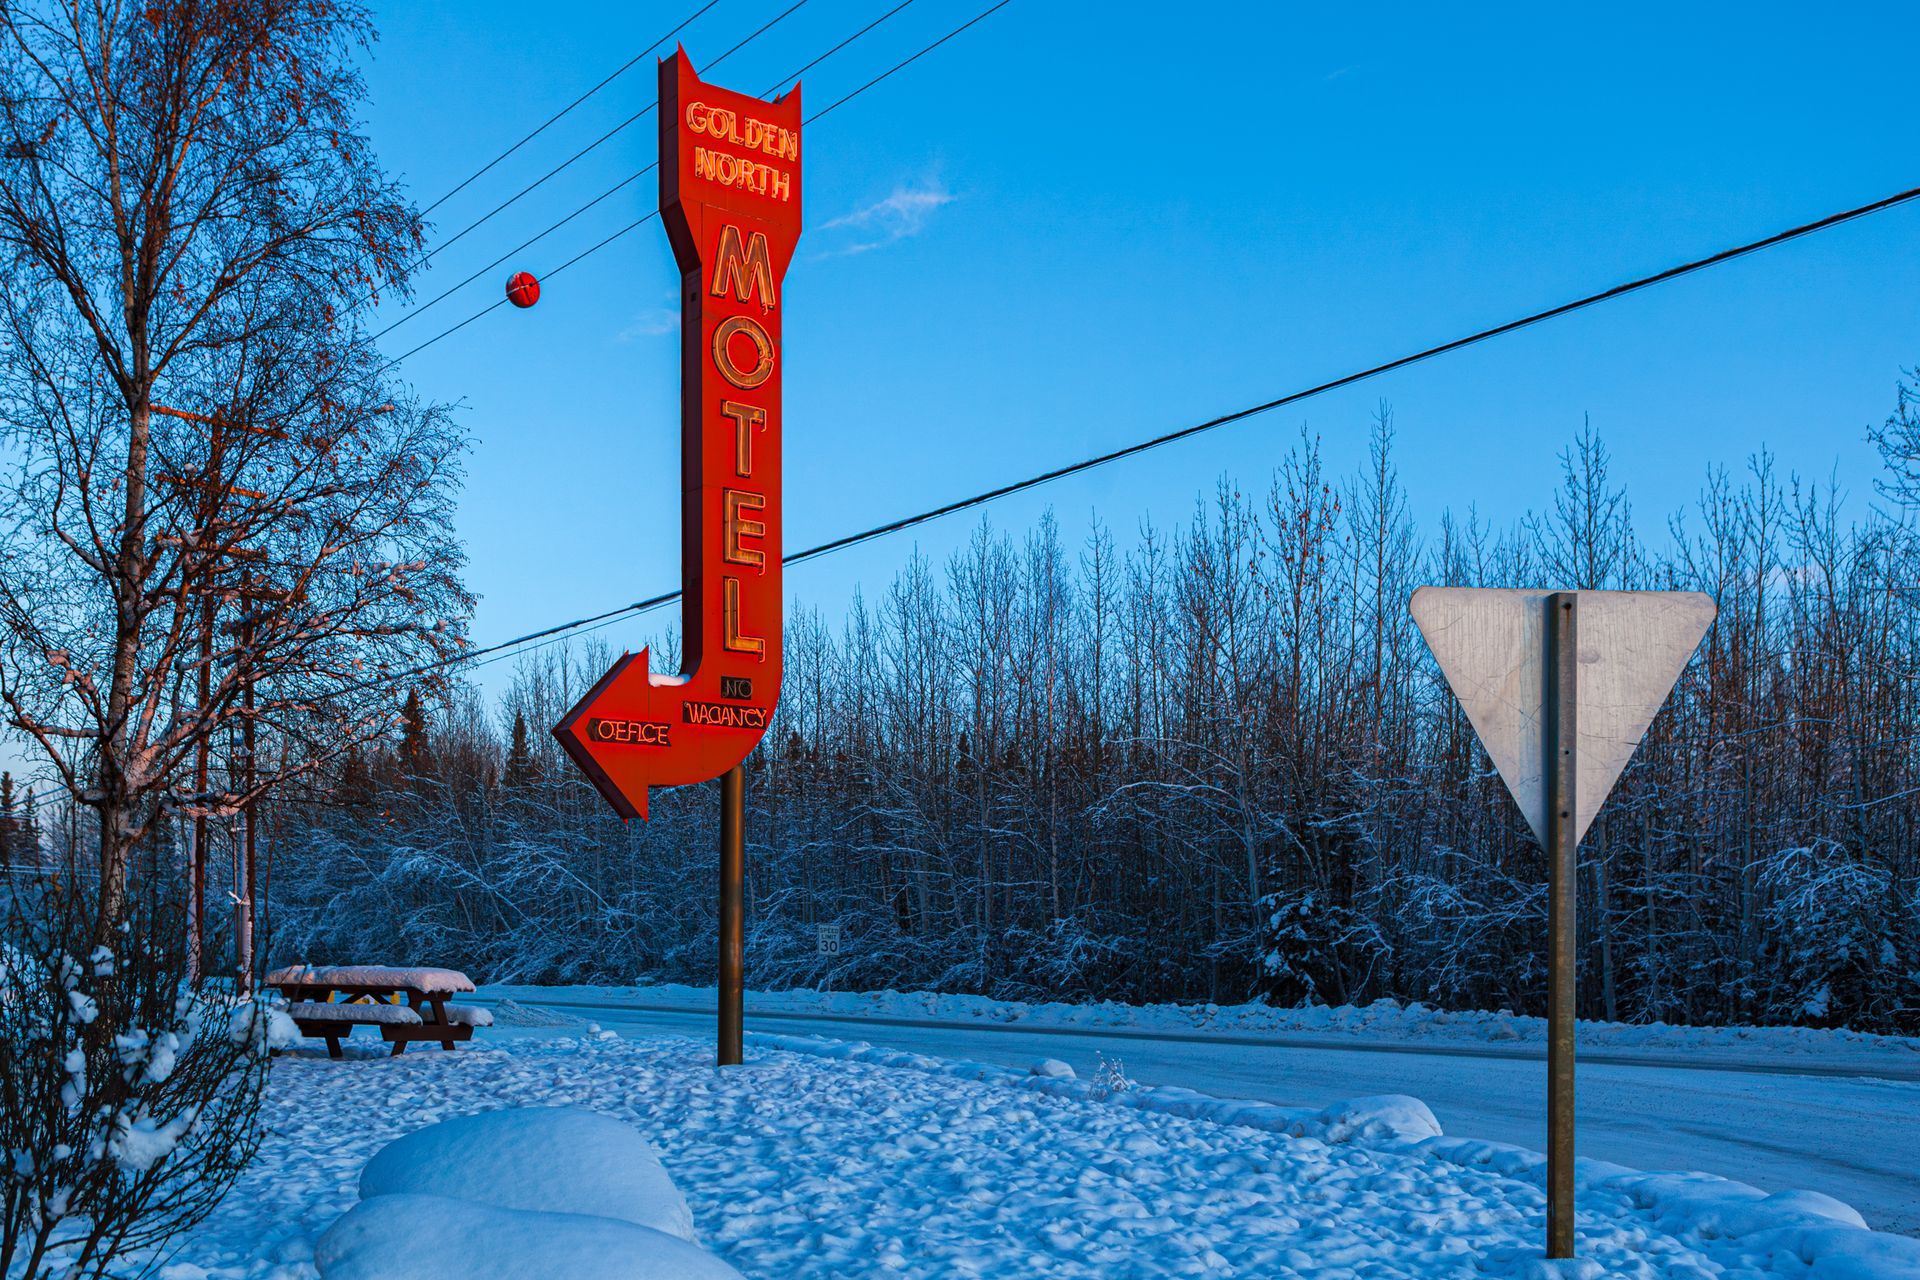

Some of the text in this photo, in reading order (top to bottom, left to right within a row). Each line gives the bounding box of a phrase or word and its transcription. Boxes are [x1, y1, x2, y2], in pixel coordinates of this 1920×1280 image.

[686, 102, 798, 161] GOLDEN
[695, 146, 790, 202] NORTH
[711, 224, 775, 660] MOTEL
[725, 679, 752, 698] NO
[684, 702, 767, 727] VACANCY
[598, 719, 669, 745] OFFICE
[820, 940, 838, 952] 30
